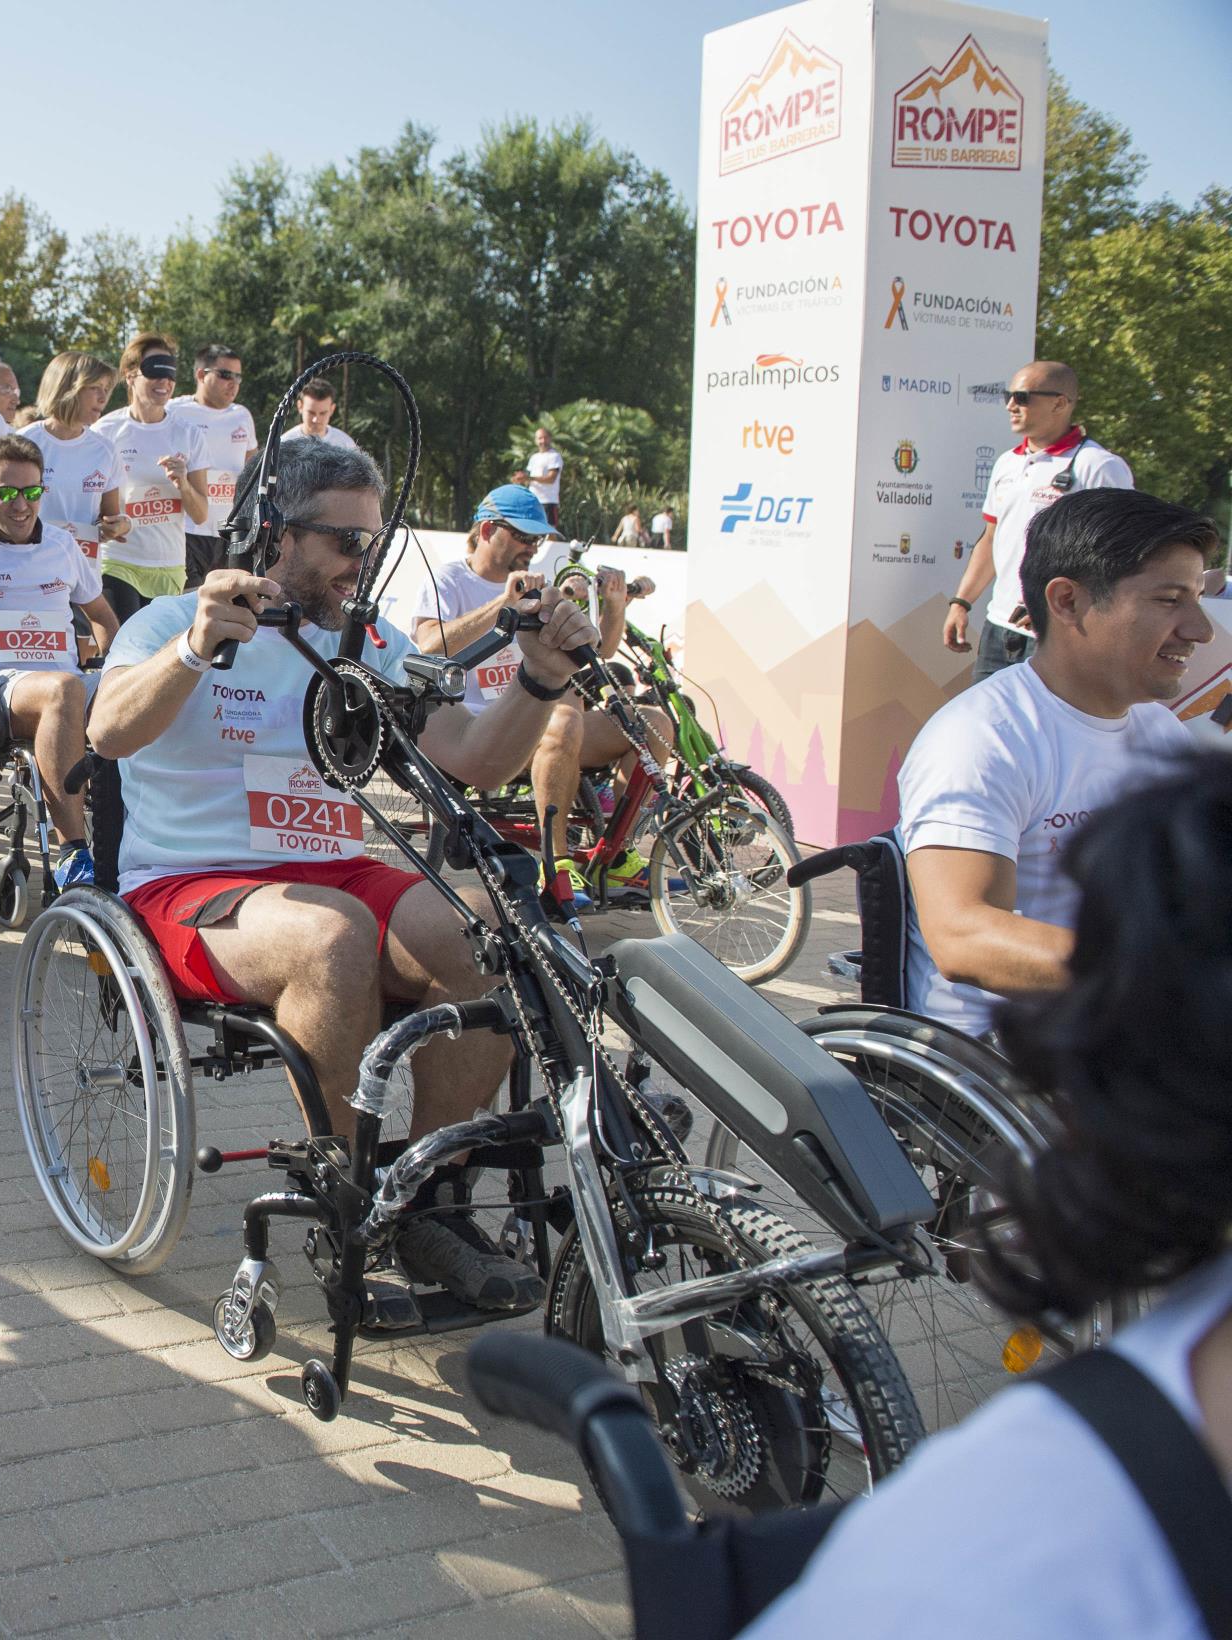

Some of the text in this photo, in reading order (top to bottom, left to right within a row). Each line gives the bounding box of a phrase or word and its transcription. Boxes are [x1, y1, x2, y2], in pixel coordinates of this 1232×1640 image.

[724, 80, 835, 151] ROMPE
[897, 105, 1017, 144] ROMPE
[745, 120, 835, 161] TUS BARRERAS
[923, 147, 1016, 164] TUS BARRERAS
[712, 201, 844, 249] TOYOTA
[889, 206, 1016, 252] TOYOTA
[736, 276, 842, 301] FUNDACIÓN A
[913, 292, 1014, 317] FUNDACIÓN A
[912, 311, 1015, 333] VÍCTIMAS DE TRÁFICO
[898, 377, 952, 395] MADRID
[742, 419, 794, 455] rtve
[208, 485, 235, 497] 018
[877, 480, 923, 490] Ayuntamiento
[876, 491, 933, 506] Valladolid
[961, 491, 986, 500] AYUNTA
[132, 499, 174, 517] 0198
[755, 496, 813, 524] DGT
[138, 515, 170, 525] TOYOTA
[872, 553, 936, 565] Manzanares El Real
[6, 631, 59, 650] 0224
[14, 651, 55, 660] TOYOTA
[212, 684, 266, 702] TOYOTA
[221, 725, 256, 744] rtve
[290, 780, 320, 789] ROMPE
[267, 795, 351, 837] 0241
[1044, 811, 1090, 830] TOYO
[276, 833, 342, 856] TOYOTA
